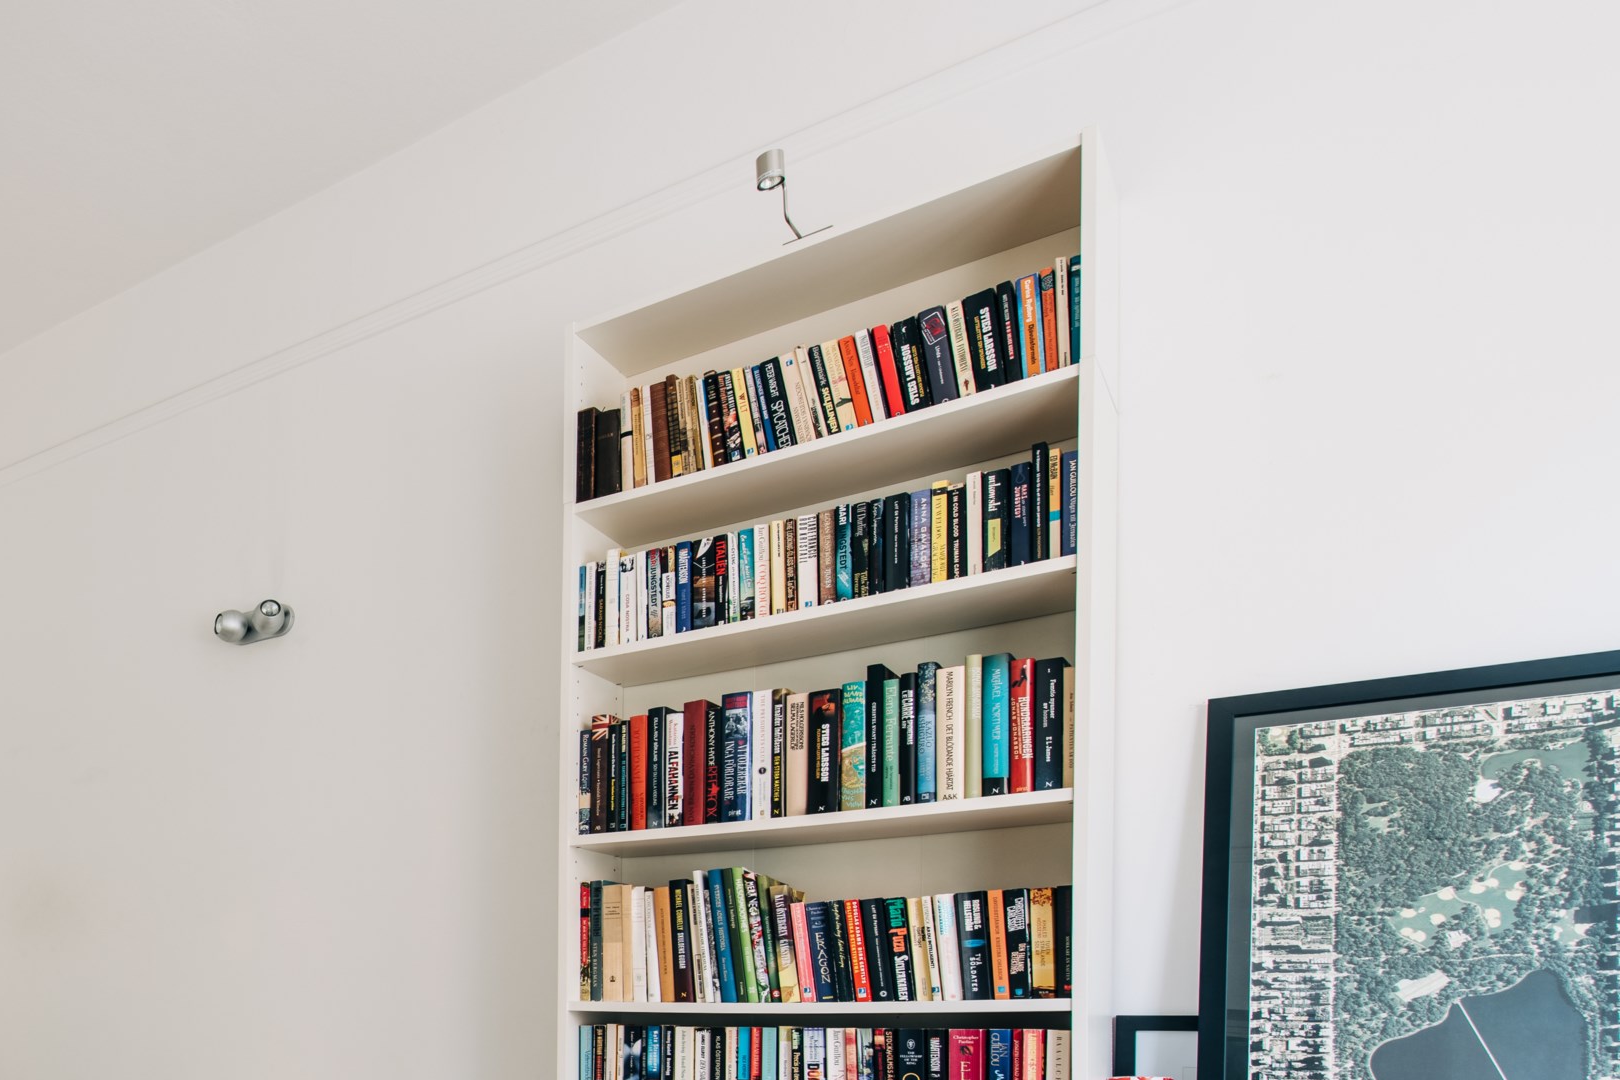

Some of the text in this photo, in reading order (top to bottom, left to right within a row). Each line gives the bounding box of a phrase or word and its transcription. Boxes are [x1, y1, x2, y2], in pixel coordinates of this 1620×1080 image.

[979, 307, 997, 371] STIEG LARSSON
[812, 346, 826, 385] Bornemark
[822, 387, 838, 433] SKILJELINJEN
[901, 344, 920, 405] STIEG LARSSON
[771, 400, 792, 449] SPYCATCHER
[725, 741, 734, 758] INGA
[886, 686, 896, 762] Elena Ferrante
[1018, 696, 1033, 759] HUNDRAÅRINGEN
[737, 754, 747, 794] TOLERERAR
[821, 724, 829, 782] STIEG LARSSON
[668, 751, 679, 810] ALFAHANNEN
[884, 899, 907, 952] Mario Puzo
[815, 932, 831, 984] ERAGON
[969, 957, 978, 992] SOLDATER
[833, 1041, 841, 1066] Guillou
[991, 1033, 1000, 1066] GUILLOU
[999, 1043, 1008, 1057] JAN
